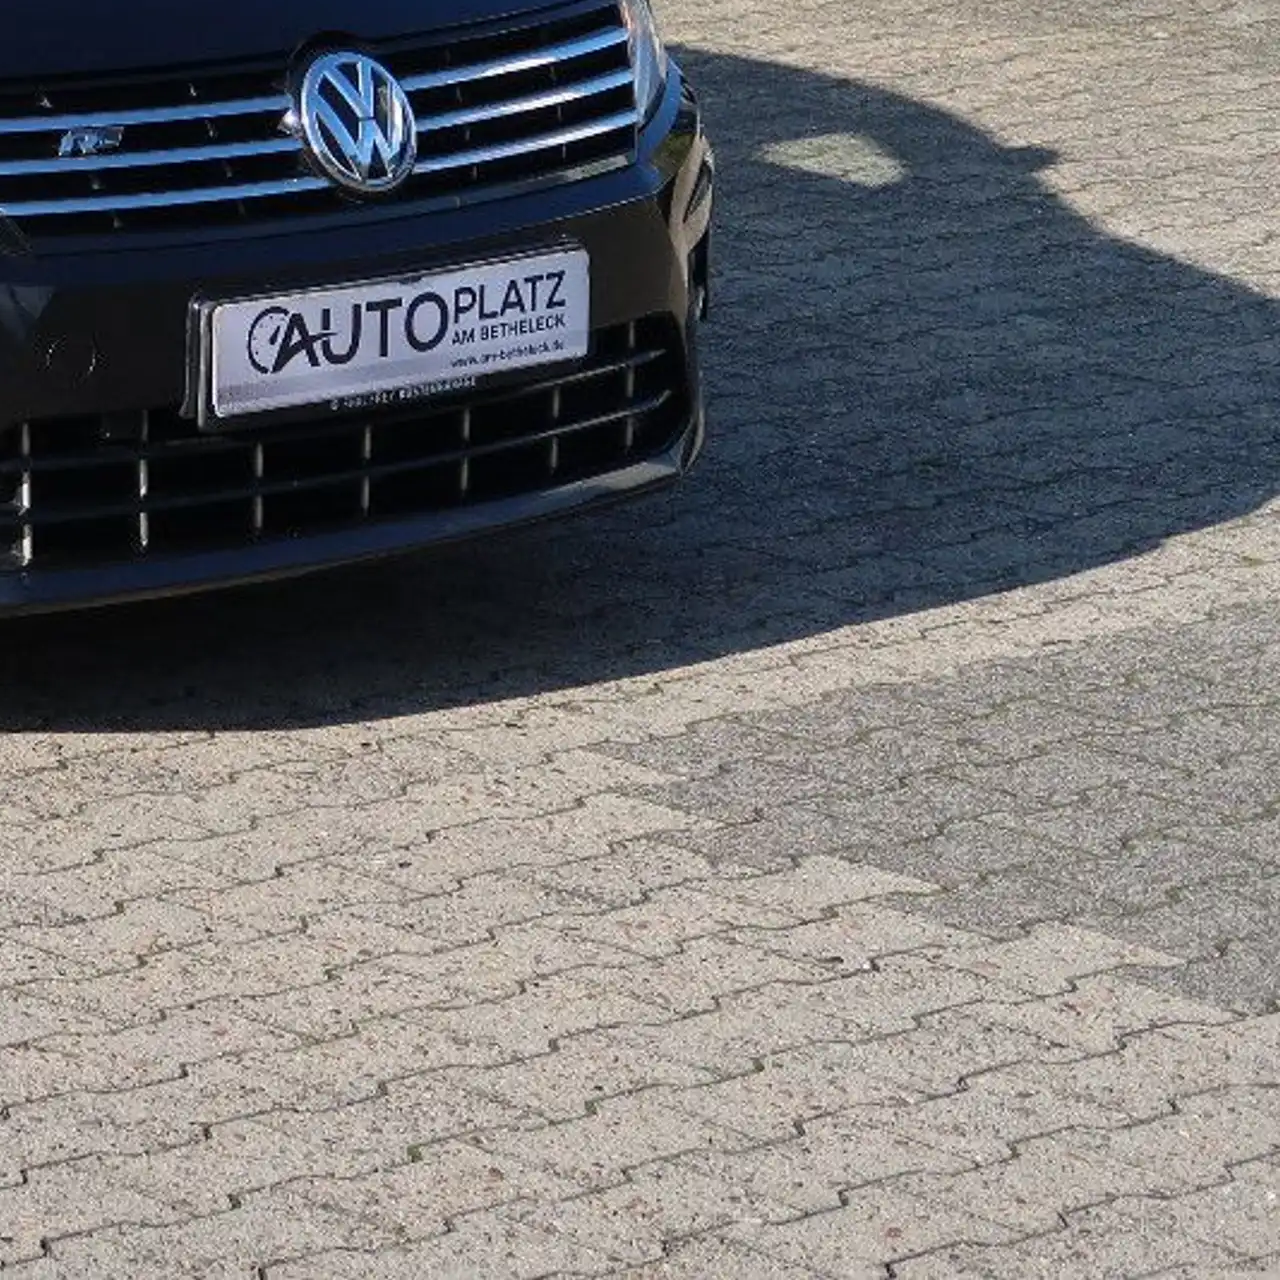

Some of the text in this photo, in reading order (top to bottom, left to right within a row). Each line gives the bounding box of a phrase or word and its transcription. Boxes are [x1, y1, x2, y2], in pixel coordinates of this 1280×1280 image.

[301, 52, 417, 191] VW
[452, 313, 566, 345] AM BETHELECK
